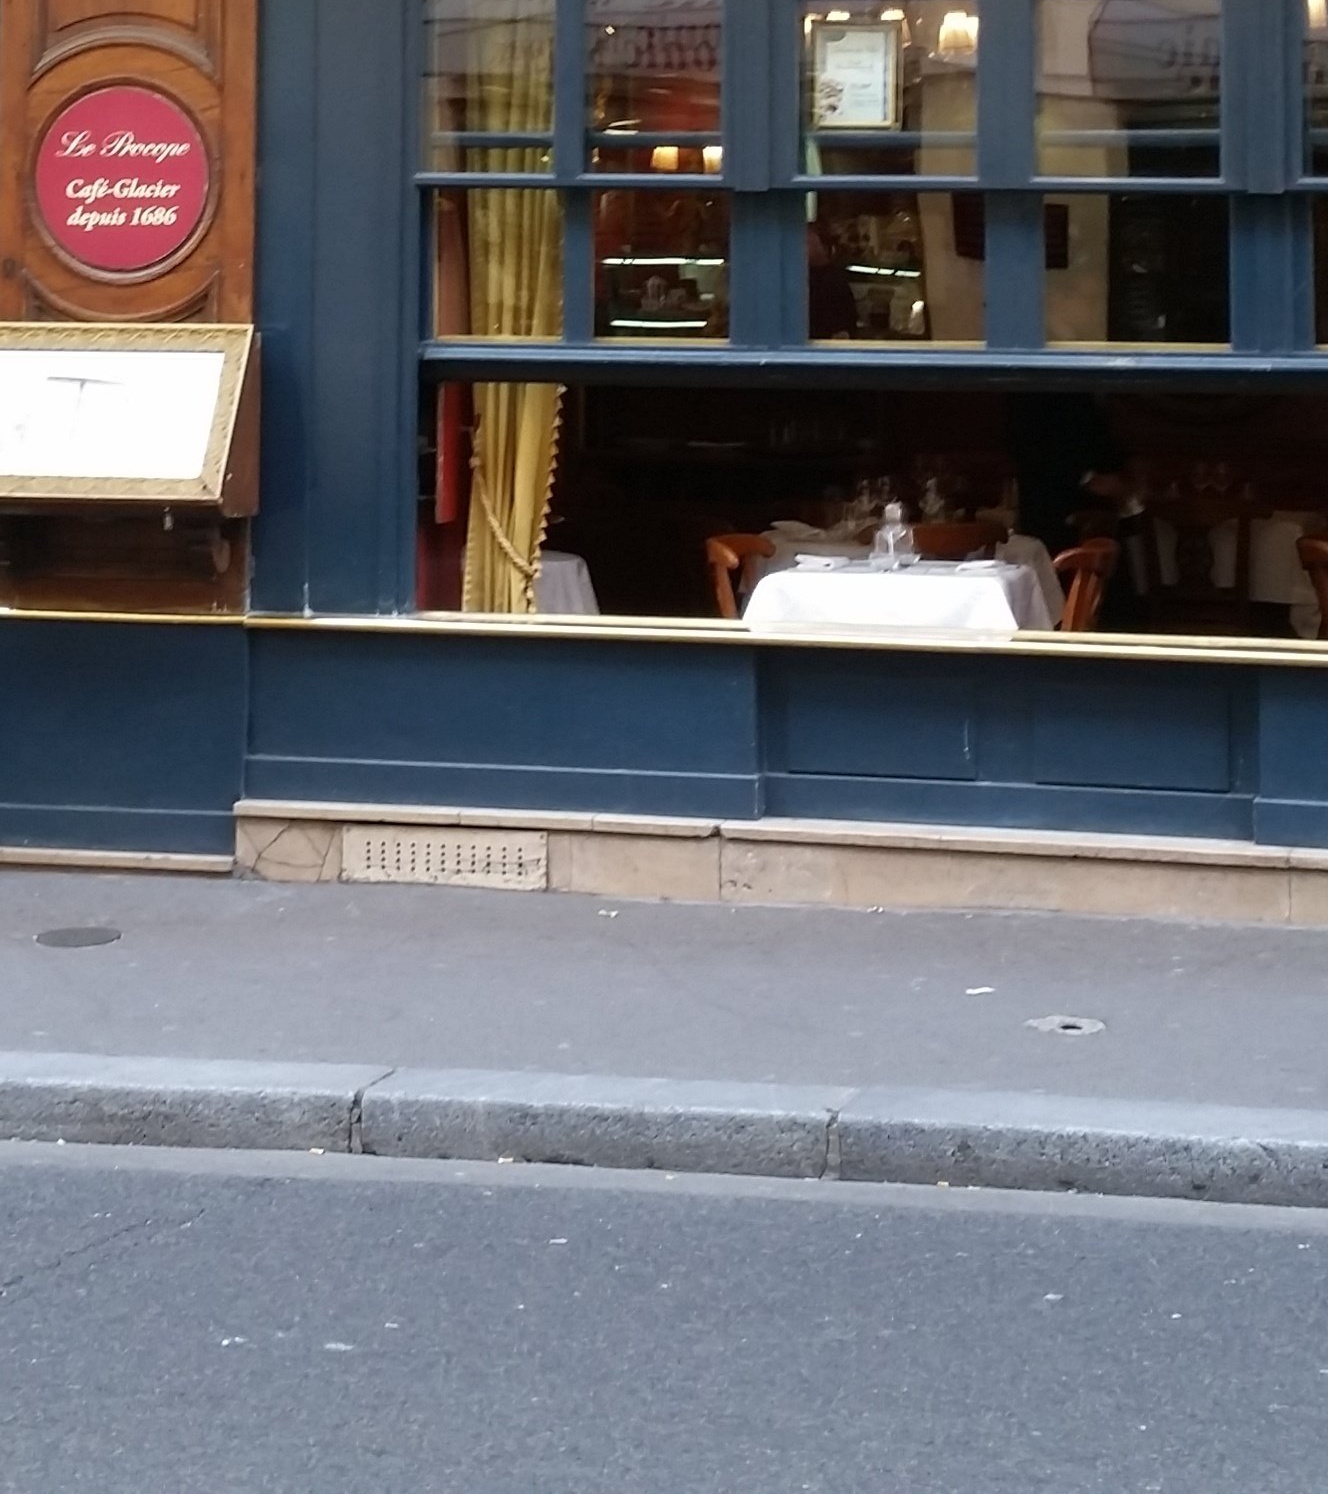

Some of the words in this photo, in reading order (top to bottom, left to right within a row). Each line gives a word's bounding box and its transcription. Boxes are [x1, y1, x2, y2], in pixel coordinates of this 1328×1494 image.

[55, 130, 97, 158] Le
[100, 130, 191, 164] Procope
[65, 177, 181, 204] Café-Glacier
[66, 205, 128, 232] depuis
[129, 205, 180, 226] 1686
